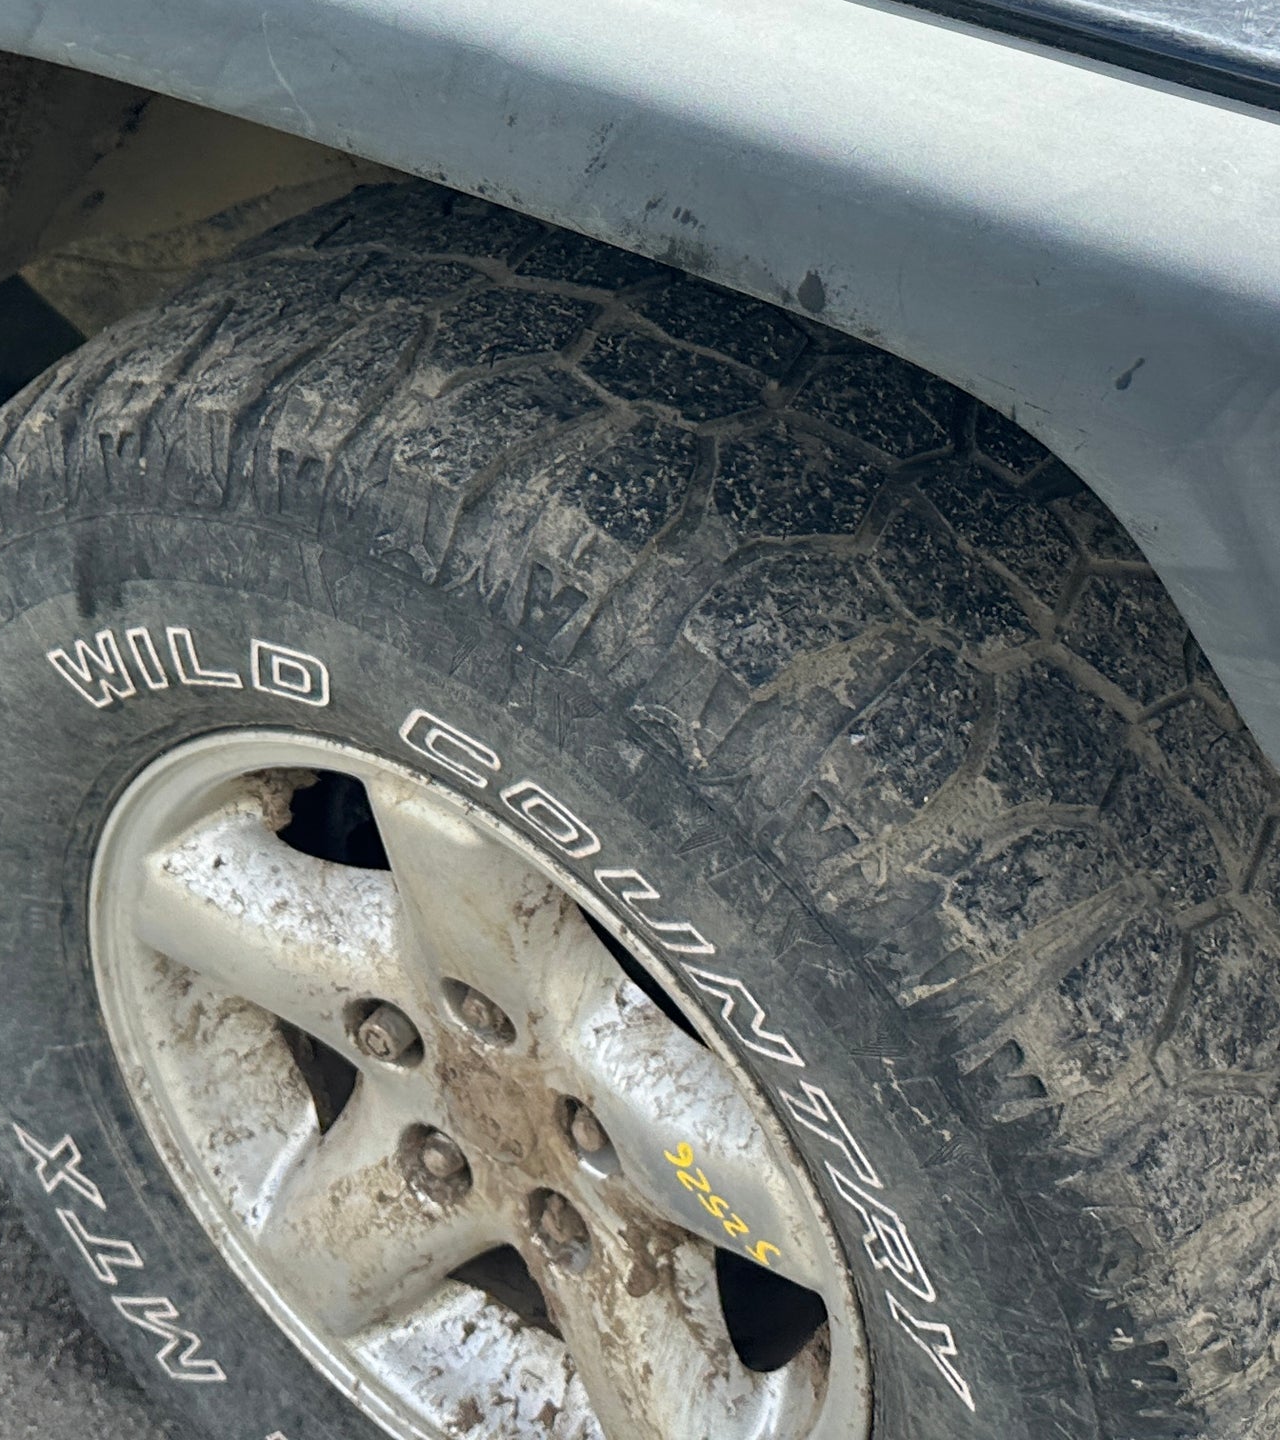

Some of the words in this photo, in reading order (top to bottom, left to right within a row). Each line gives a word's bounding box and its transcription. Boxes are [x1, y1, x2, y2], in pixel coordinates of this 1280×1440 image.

[12, 1121, 228, 1382] MTX
[46, 626, 331, 709] WILD
[398, 707, 976, 1413] COUNTRY
